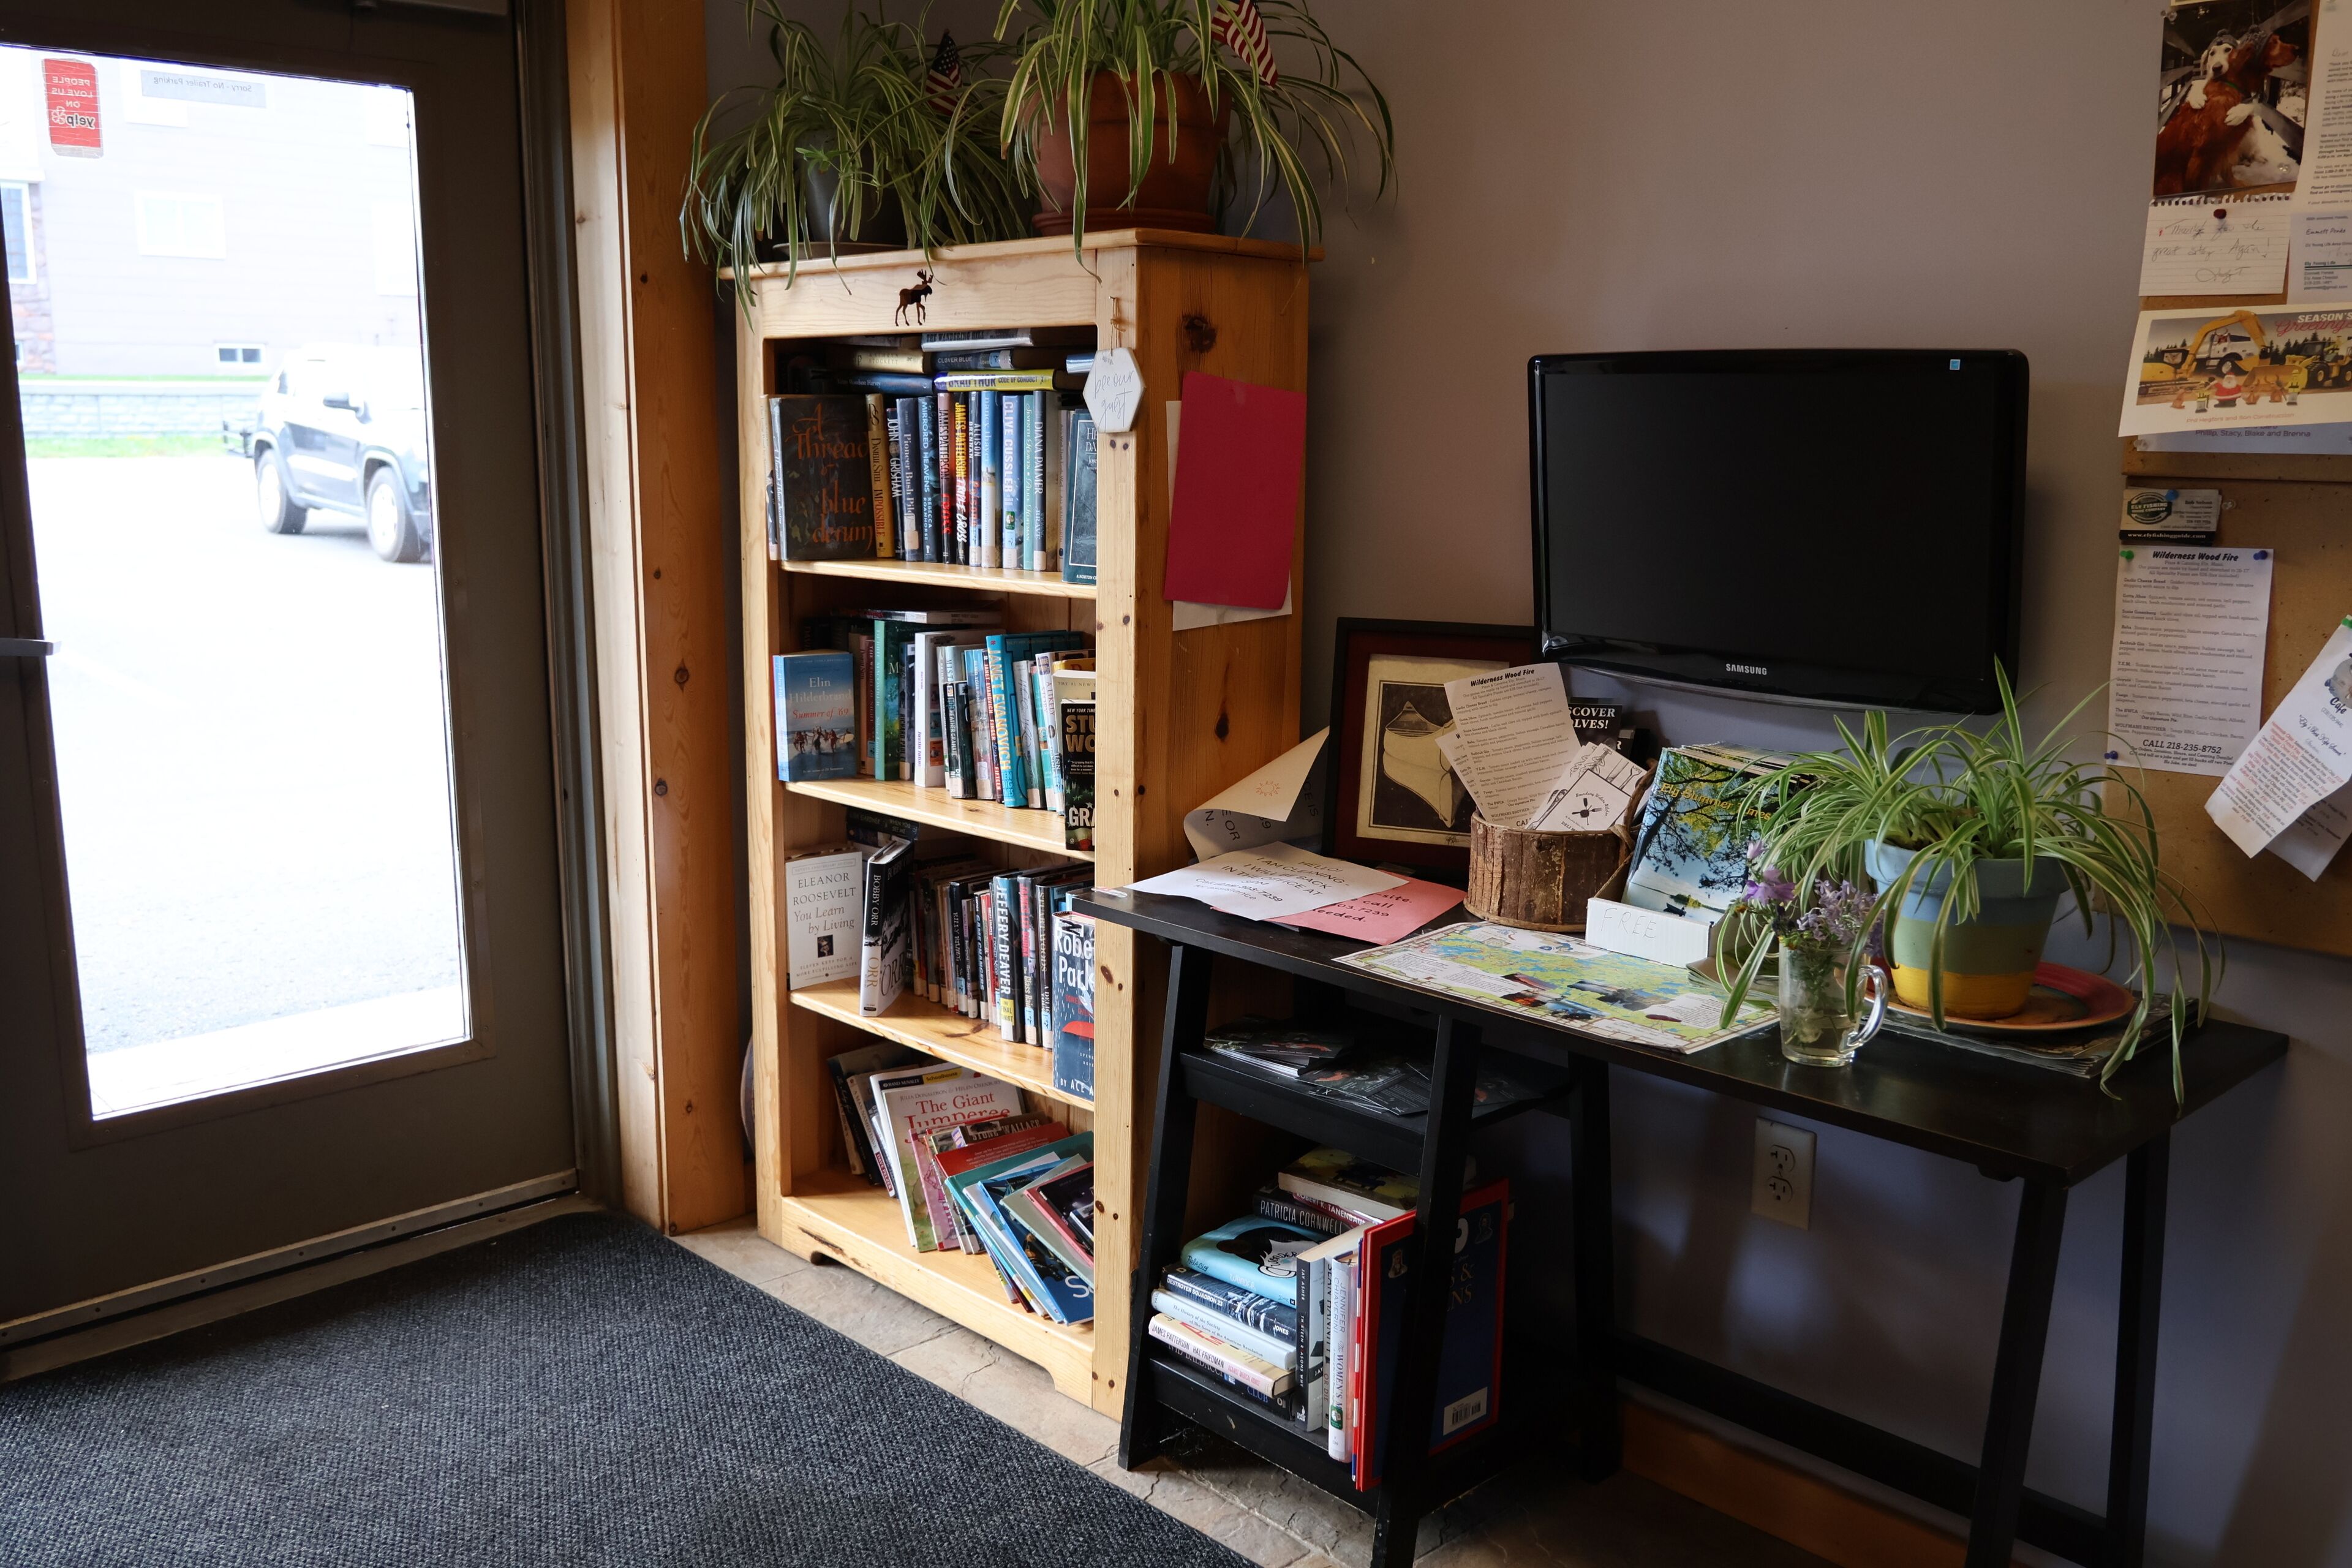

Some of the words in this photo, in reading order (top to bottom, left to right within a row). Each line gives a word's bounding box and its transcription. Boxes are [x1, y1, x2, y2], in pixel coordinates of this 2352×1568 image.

[938, 408, 949, 437] JAMES
[955, 402, 966, 431] JAMES
[984, 397, 993, 429] nancy
[1004, 401, 1014, 435] CLIVE
[887, 418, 900, 442] JOHN
[973, 423, 982, 458] ALLISON
[1034, 421, 1043, 454] DIANA
[2220, 429, 2243, 438] Stacy,
[903, 433, 913, 469] Pioneer
[939, 437, 950, 480] PATTERSON
[955, 431, 967, 478] PATTERSON
[1003, 439, 1014, 492] CUSSLER
[1034, 456, 1044, 495] PALMER
[889, 458, 903, 498] GRISHAM
[905, 471, 914, 496] Bush
[956, 478, 967, 512] TRIPLE
[873, 489, 886, 537] IMPOSSIBLE
[956, 513, 969, 543] CROSS
[2152, 550, 2196, 561] Wilderness
[2198, 552, 2221, 562] Wood
[2222, 553, 2239, 562] Fire
[987, 647, 1005, 692] JANET
[1470, 674, 1503, 687] Wilderness
[1504, 670, 1521, 680] Wood
[1725, 663, 1768, 676] SAMSUNG
[809, 677, 831, 688] Elin
[788, 689, 853, 704] Hilderbrand
[1046, 689, 1056, 716] LIKELY
[2329, 696, 2348, 715] Cafe
[792, 707, 824, 720] Summer
[826, 707, 834, 719] of
[837, 707, 850, 717] '69
[990, 693, 1011, 772] EVANOVICH
[2143, 739, 2165, 749] CALL
[2166, 741, 2222, 754] 218-235-8752
[1659, 783, 1680, 798] Ely
[1681, 788, 1734, 810] Summer
[1250, 865, 1278, 876] WILL
[1295, 875, 1333, 889] BACK
[1286, 866, 1346, 884] CLEANING
[1298, 861, 1343, 873] HELLO!
[798, 872, 851, 889] ELEANOR
[872, 874, 882, 906] BOBBY
[1260, 876, 1305, 889] OFFICE
[793, 887, 857, 907] ROOSEVELT
[1237, 884, 1283, 902] 303-7239
[1362, 900, 1395, 909] call
[794, 910, 812, 924] You
[815, 905, 845, 920] Learn
[870, 907, 880, 927] ORR
[996, 885, 1009, 943] JEFFERY
[1600, 907, 1657, 939] FREE
[808, 922, 820, 937] by
[823, 918, 856, 933] Living
[796, 969, 811, 978] MORE
[799, 961, 820, 971] ELEVEN
[866, 957, 880, 988] ORR
[999, 945, 1011, 995] DEAVER
[925, 1071, 959, 1081] Schoolhouse
[1060, 1077, 1067, 1088] BY
[1070, 1079, 1085, 1094] ACE
[914, 1089, 948, 1100] DONALDSON
[915, 1099, 949, 1116] The
[952, 1091, 995, 1109] Giant
[1000, 1118, 1041, 1135] WALLACE
[876, 1153, 885, 1169] DAVE
[882, 1169, 892, 1191] PELZER
[1260, 1200, 1297, 1224] PATRICIA
[1298, 1210, 1343, 1236] CORNWELL
[1187, 1255, 1209, 1272] Palacio
[1166, 1277, 1192, 1293] DESTROYER
[1191, 1287, 1218, 1303] SQUADRON
[1273, 1325, 1290, 1336] JONES
[1180, 1308, 1195, 1317] History
[1206, 1321, 1221, 1330] Society
[1151, 1324, 1167, 1340] JAMES
[1166, 1331, 1190, 1351] PATTERSON
[1192, 1346, 1202, 1357] HAL
[1202, 1351, 1225, 1369] FRIEDMAN
[1227, 1364, 1240, 1375] AGAINST
[1239, 1371, 1251, 1382] MEDICAL
[1250, 1377, 1261, 1387] ADVICE
[1223, 1335, 1242, 1347] American
[1242, 1341, 1264, 1357] Revolution
[1324, 1373, 1329, 1387] OR
